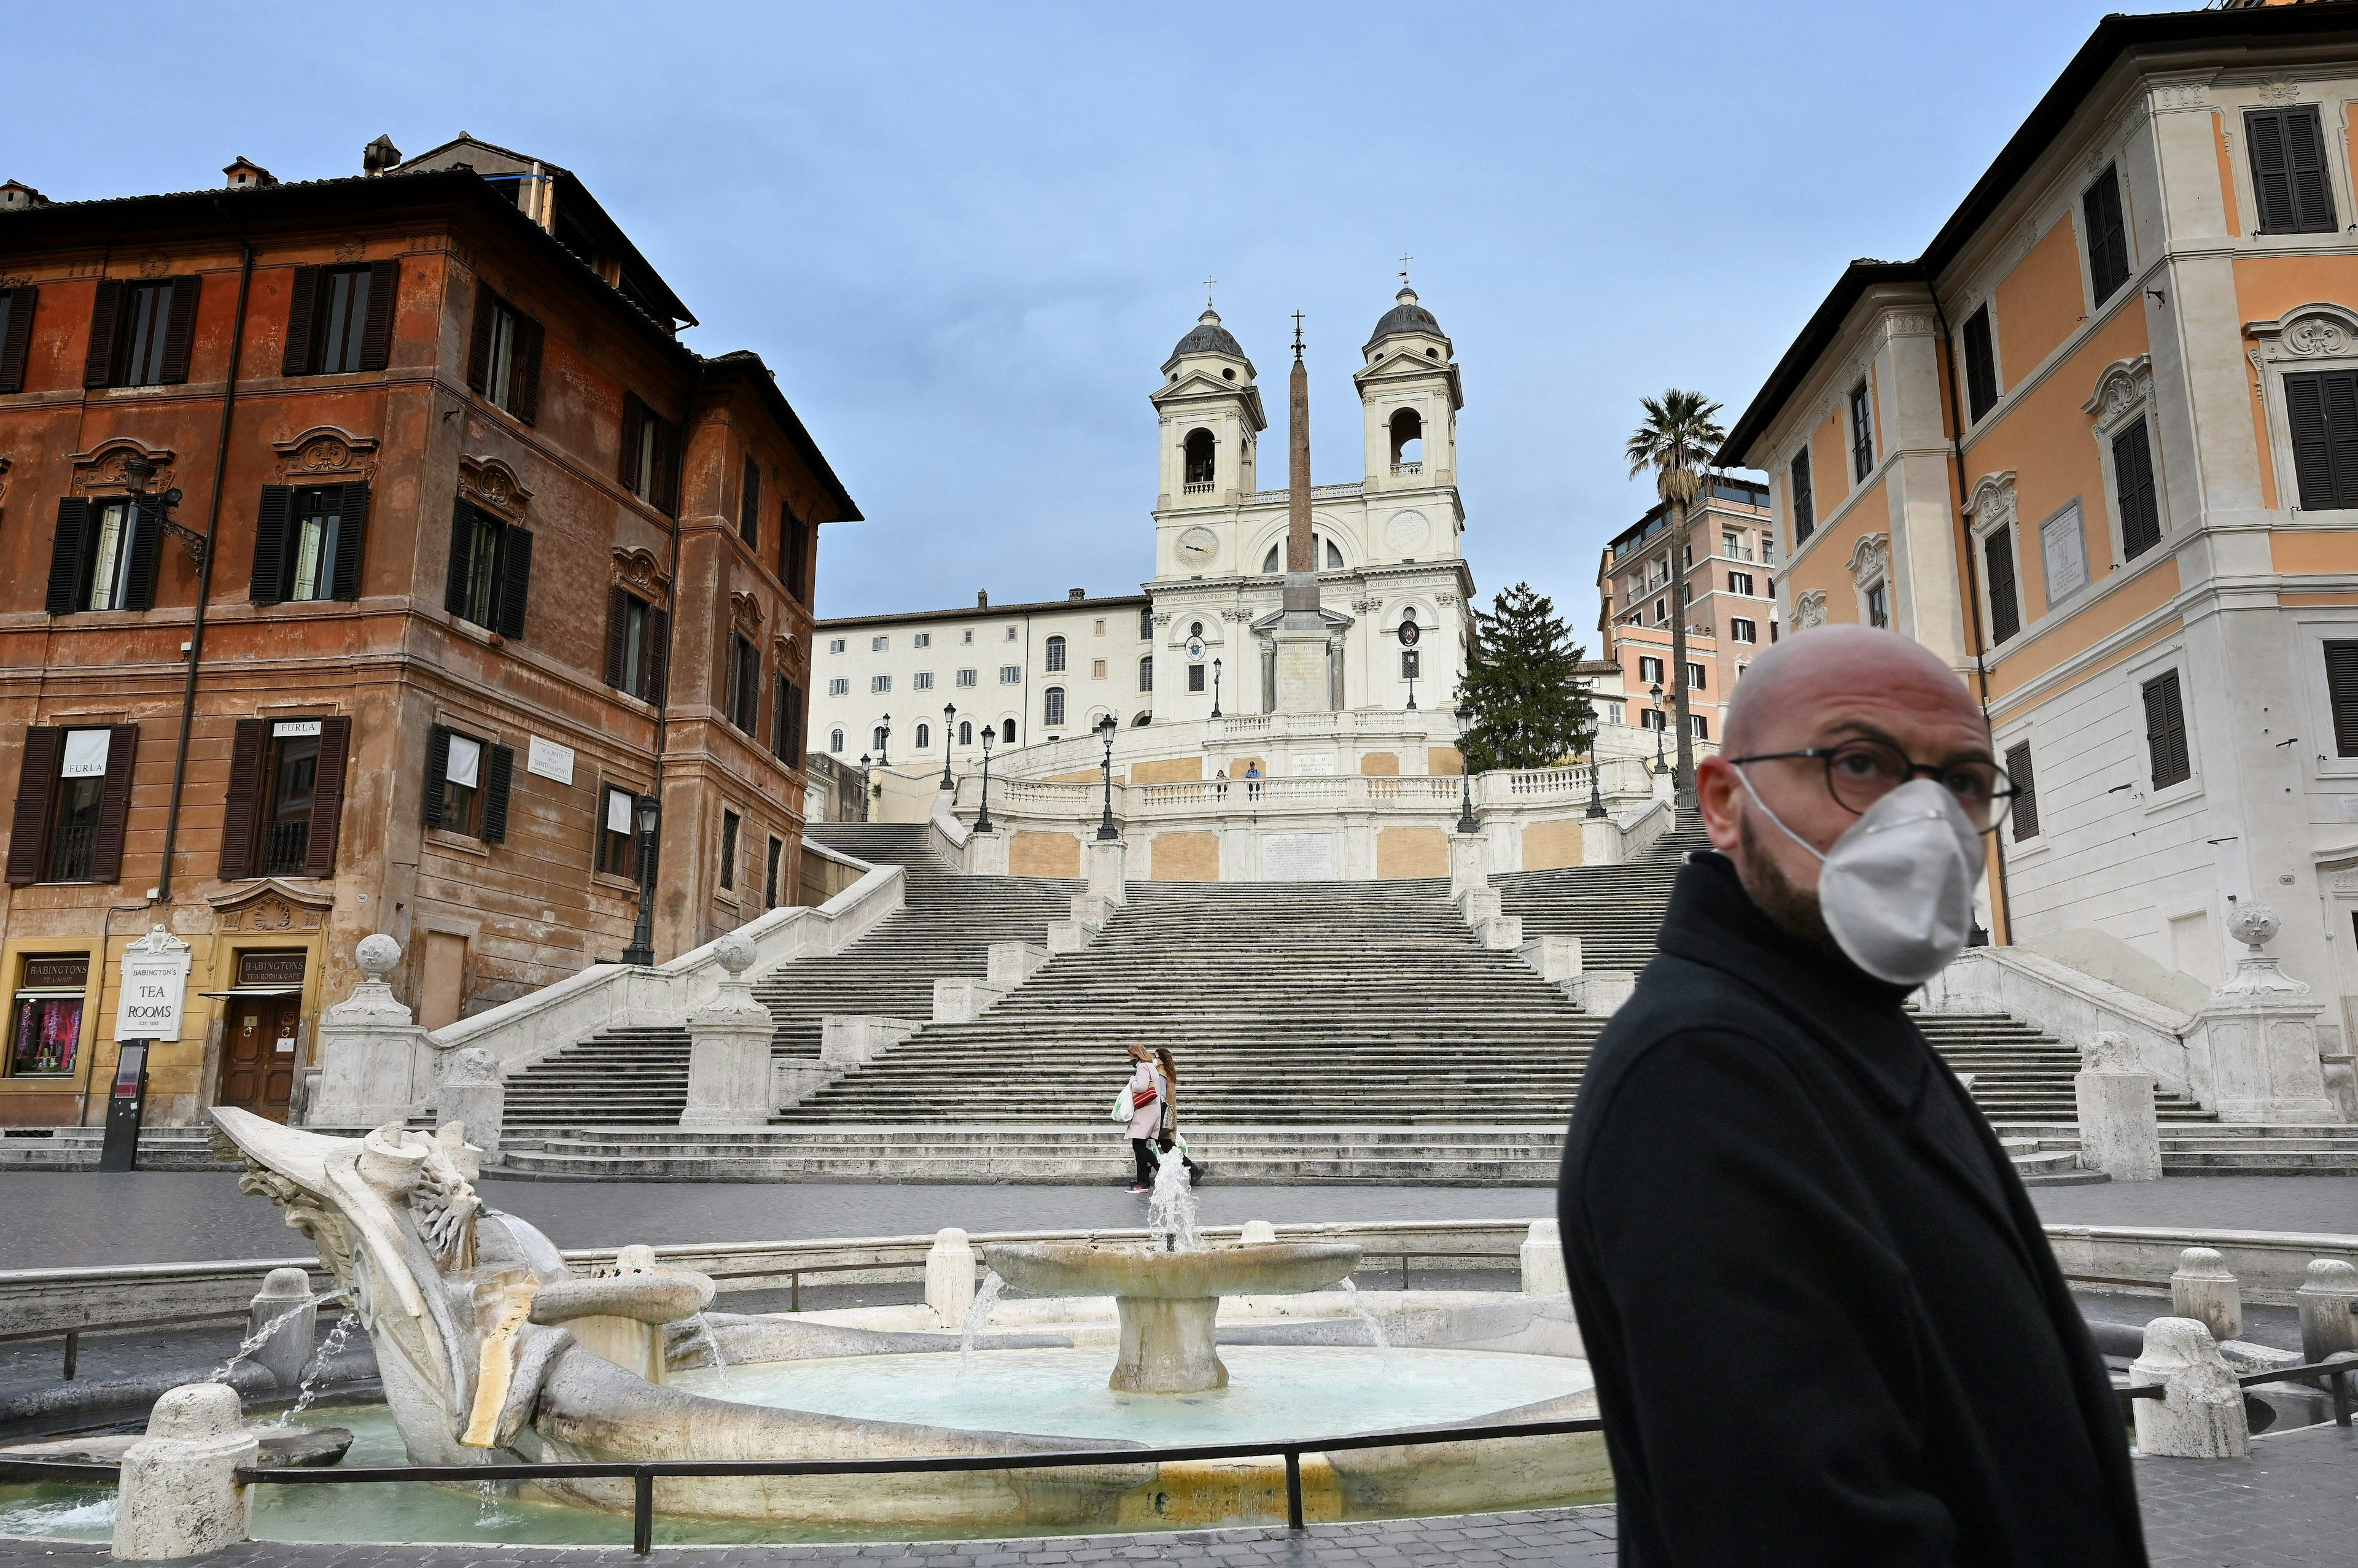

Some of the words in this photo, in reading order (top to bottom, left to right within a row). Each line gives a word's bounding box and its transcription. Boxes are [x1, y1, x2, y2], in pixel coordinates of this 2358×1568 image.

[281, 723, 315, 732] FURLA
[542, 747, 564, 760] SCALINATA
[69, 764, 103, 773] FURLA
[555, 766, 569, 776] MONTI
[30, 965, 87, 975] BABINGTONS
[246, 961, 304, 971] BABINGTONS
[139, 985, 165, 998] TEA
[128, 1006, 172, 1018] ROOMS
